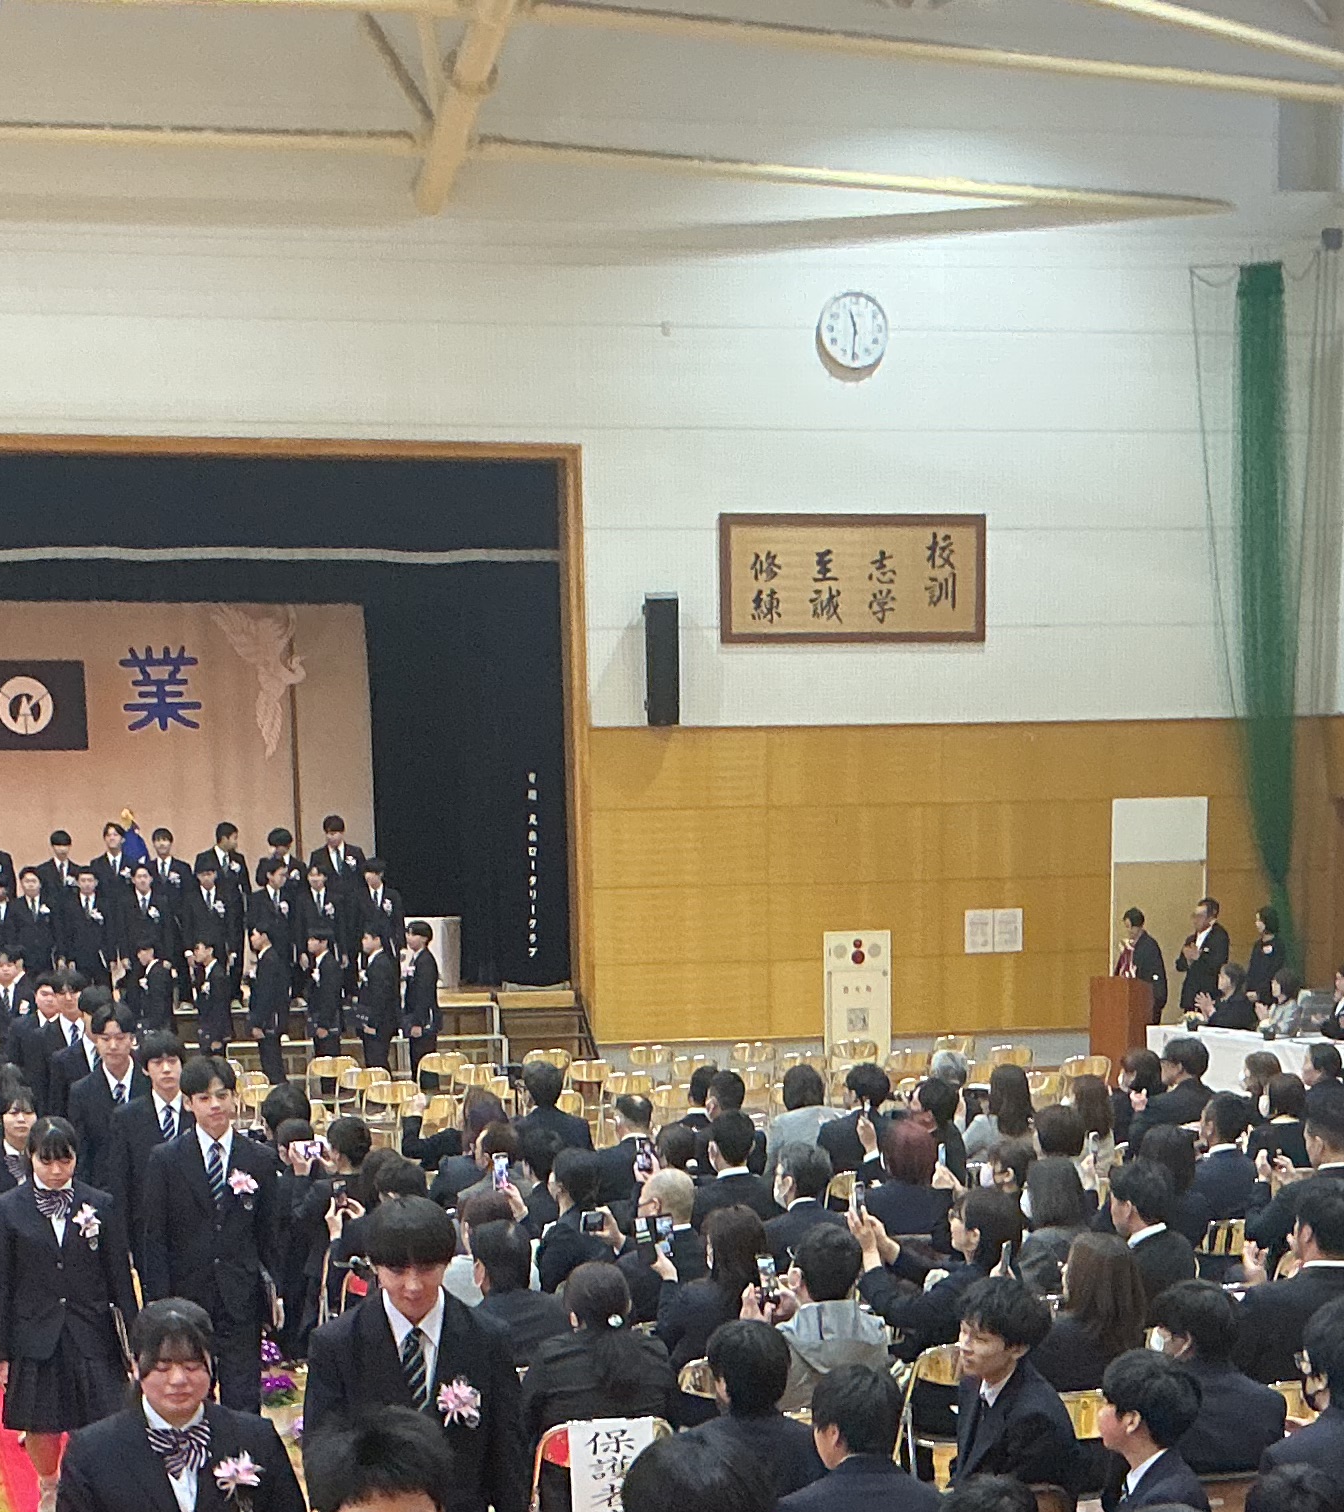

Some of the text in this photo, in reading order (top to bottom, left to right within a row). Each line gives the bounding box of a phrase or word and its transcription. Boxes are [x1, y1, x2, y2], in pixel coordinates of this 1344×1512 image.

[749, 550, 783, 625] 修練
[808, 548, 844, 625] 至誠
[867, 549, 898, 625] 志学
[924, 531, 957, 612] 校訓
[118, 645, 202, 732] 業
